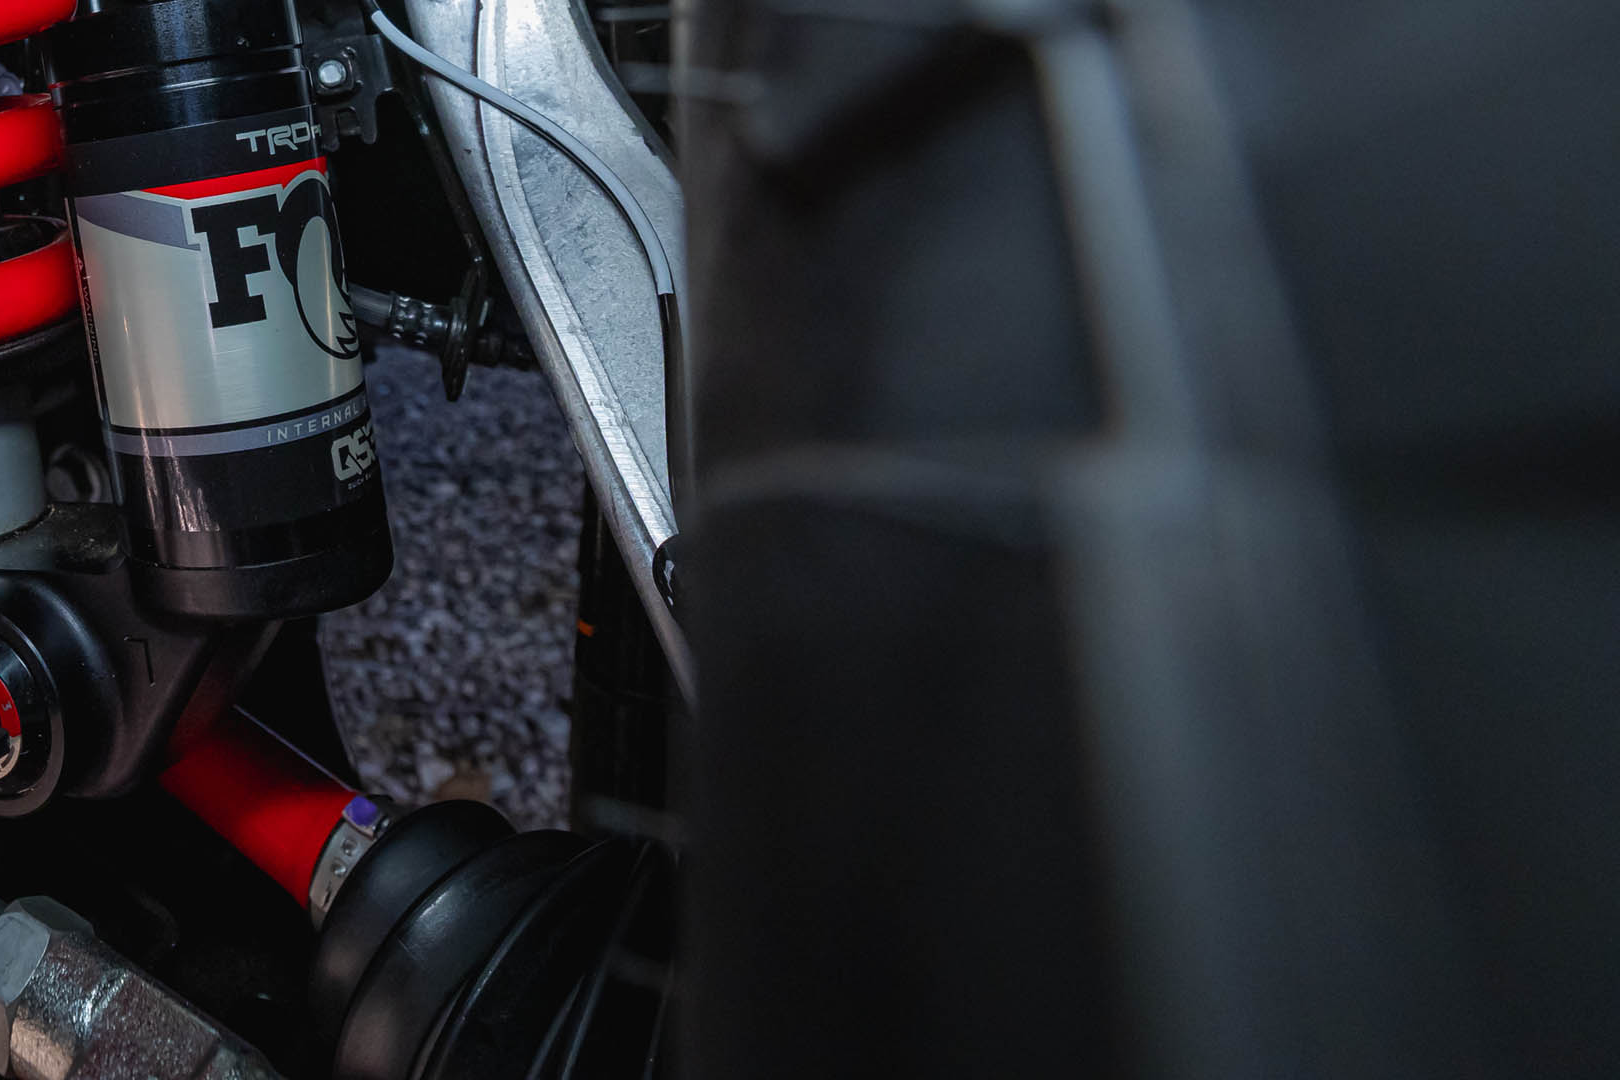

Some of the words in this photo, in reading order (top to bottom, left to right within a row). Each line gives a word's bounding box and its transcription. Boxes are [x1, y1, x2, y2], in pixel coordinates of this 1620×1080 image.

[235, 121, 311, 155] TRD
[191, 177, 361, 360] FO
[267, 402, 360, 443] INTERNAL
